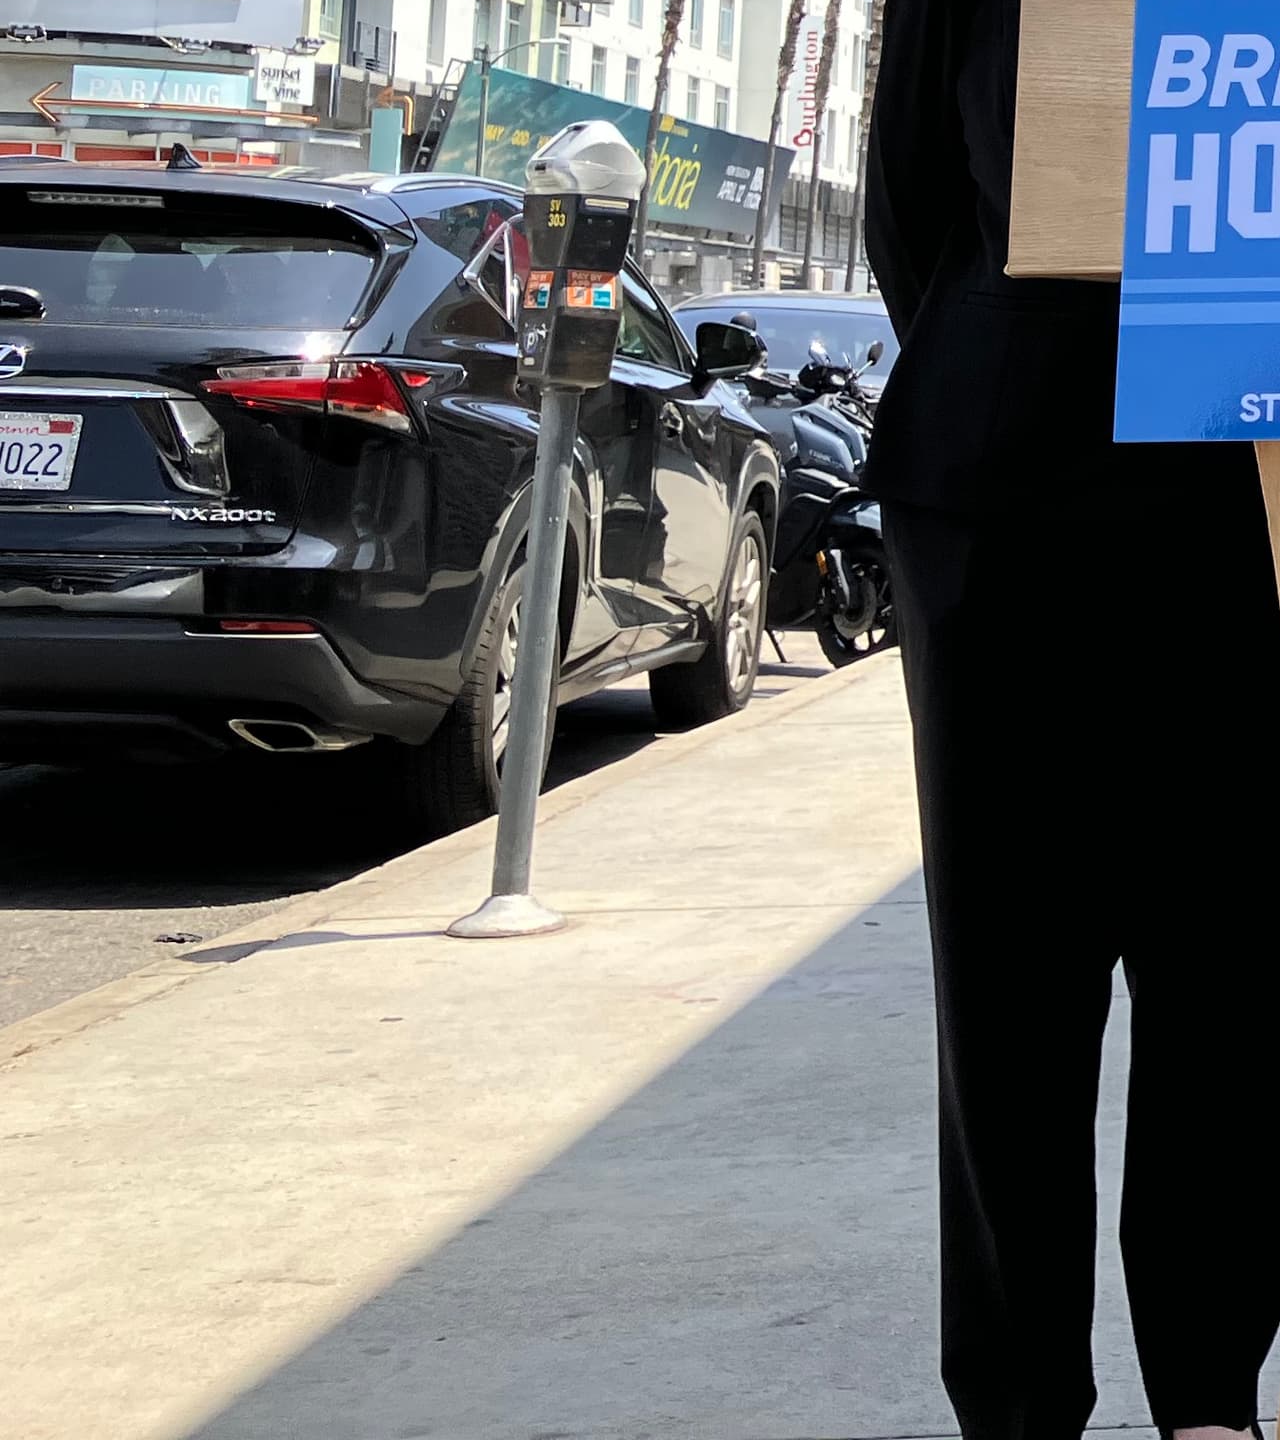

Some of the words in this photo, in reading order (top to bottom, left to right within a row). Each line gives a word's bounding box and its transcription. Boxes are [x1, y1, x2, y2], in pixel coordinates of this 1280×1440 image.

[261, 67, 300, 81] sunset
[89, 78, 222, 105] PARKING
[273, 83, 300, 100] vine
[550, 199, 561, 211] SV
[548, 213, 566, 228] 303
[171, 506, 277, 522] NX200t
